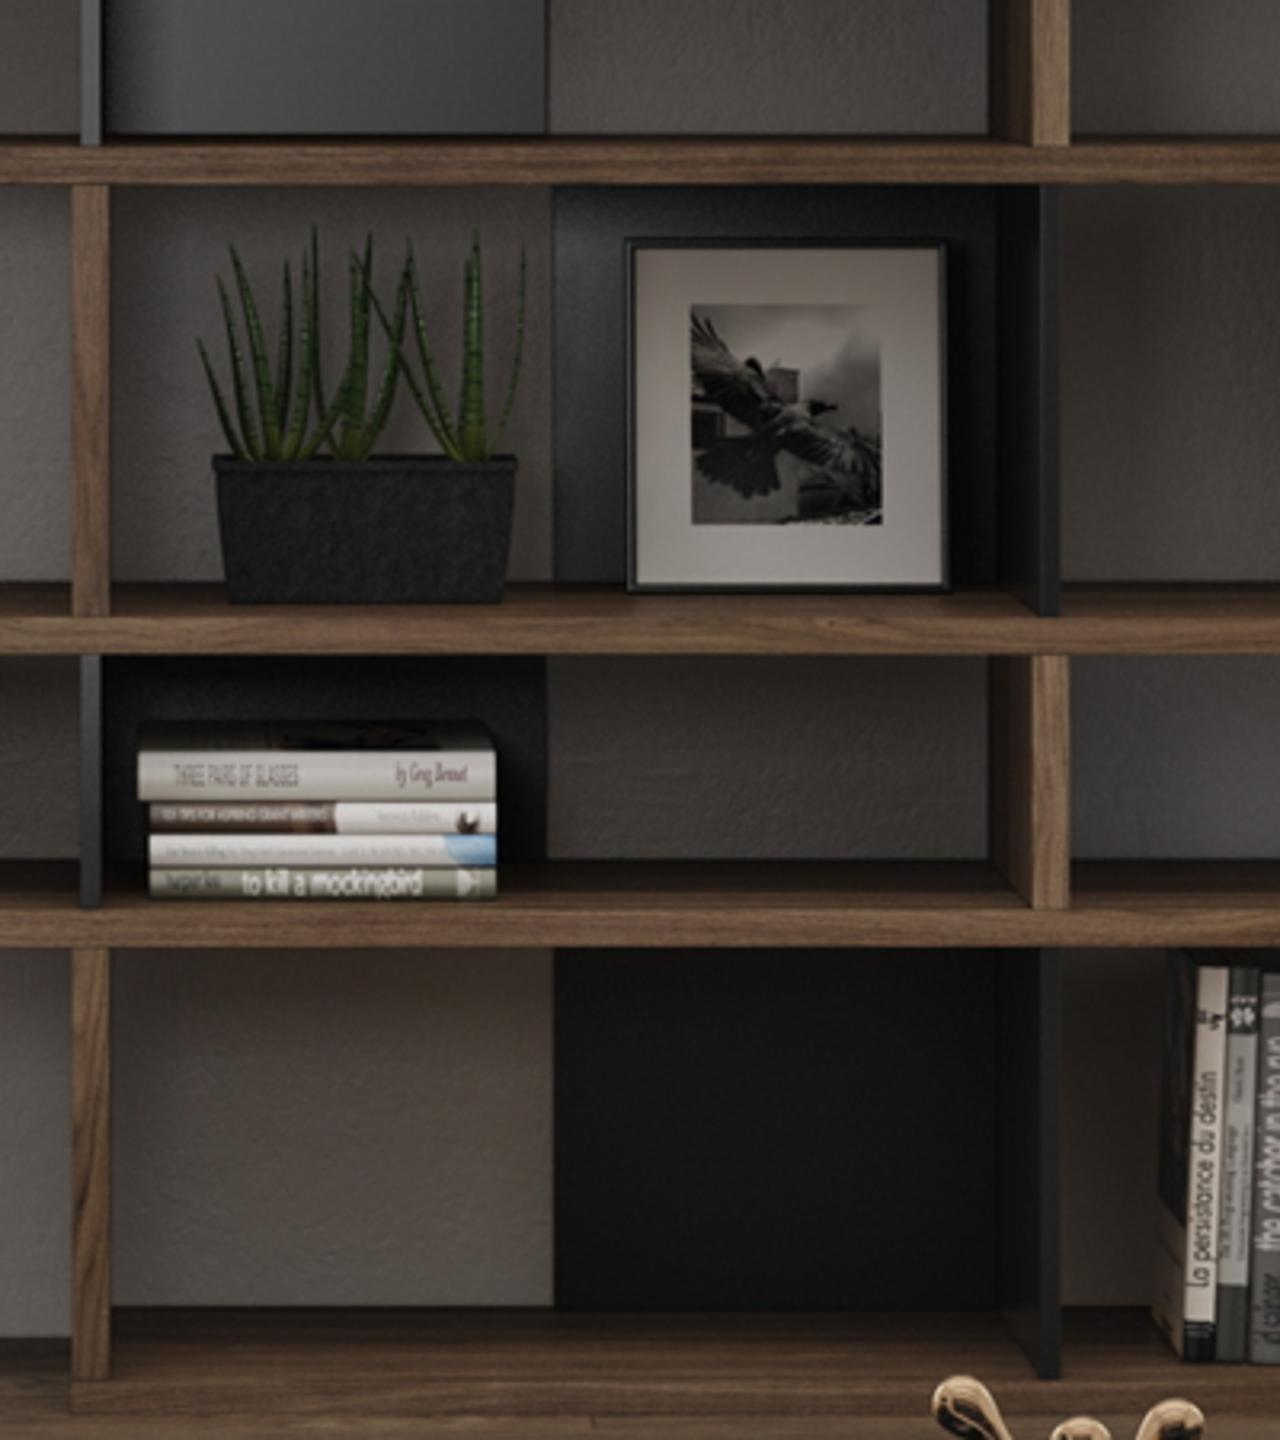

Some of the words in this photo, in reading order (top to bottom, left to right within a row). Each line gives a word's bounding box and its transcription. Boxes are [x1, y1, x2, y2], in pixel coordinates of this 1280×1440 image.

[240, 763, 252, 788] OF
[255, 763, 299, 788] GLASSES
[395, 761, 406, 789] by
[241, 871, 261, 896] to
[265, 869, 288, 896] kill
[294, 873, 307, 896] a
[311, 869, 423, 898] mockingbird
[1192, 1071, 1217, 1126] destin
[1192, 1131, 1216, 1155] du
